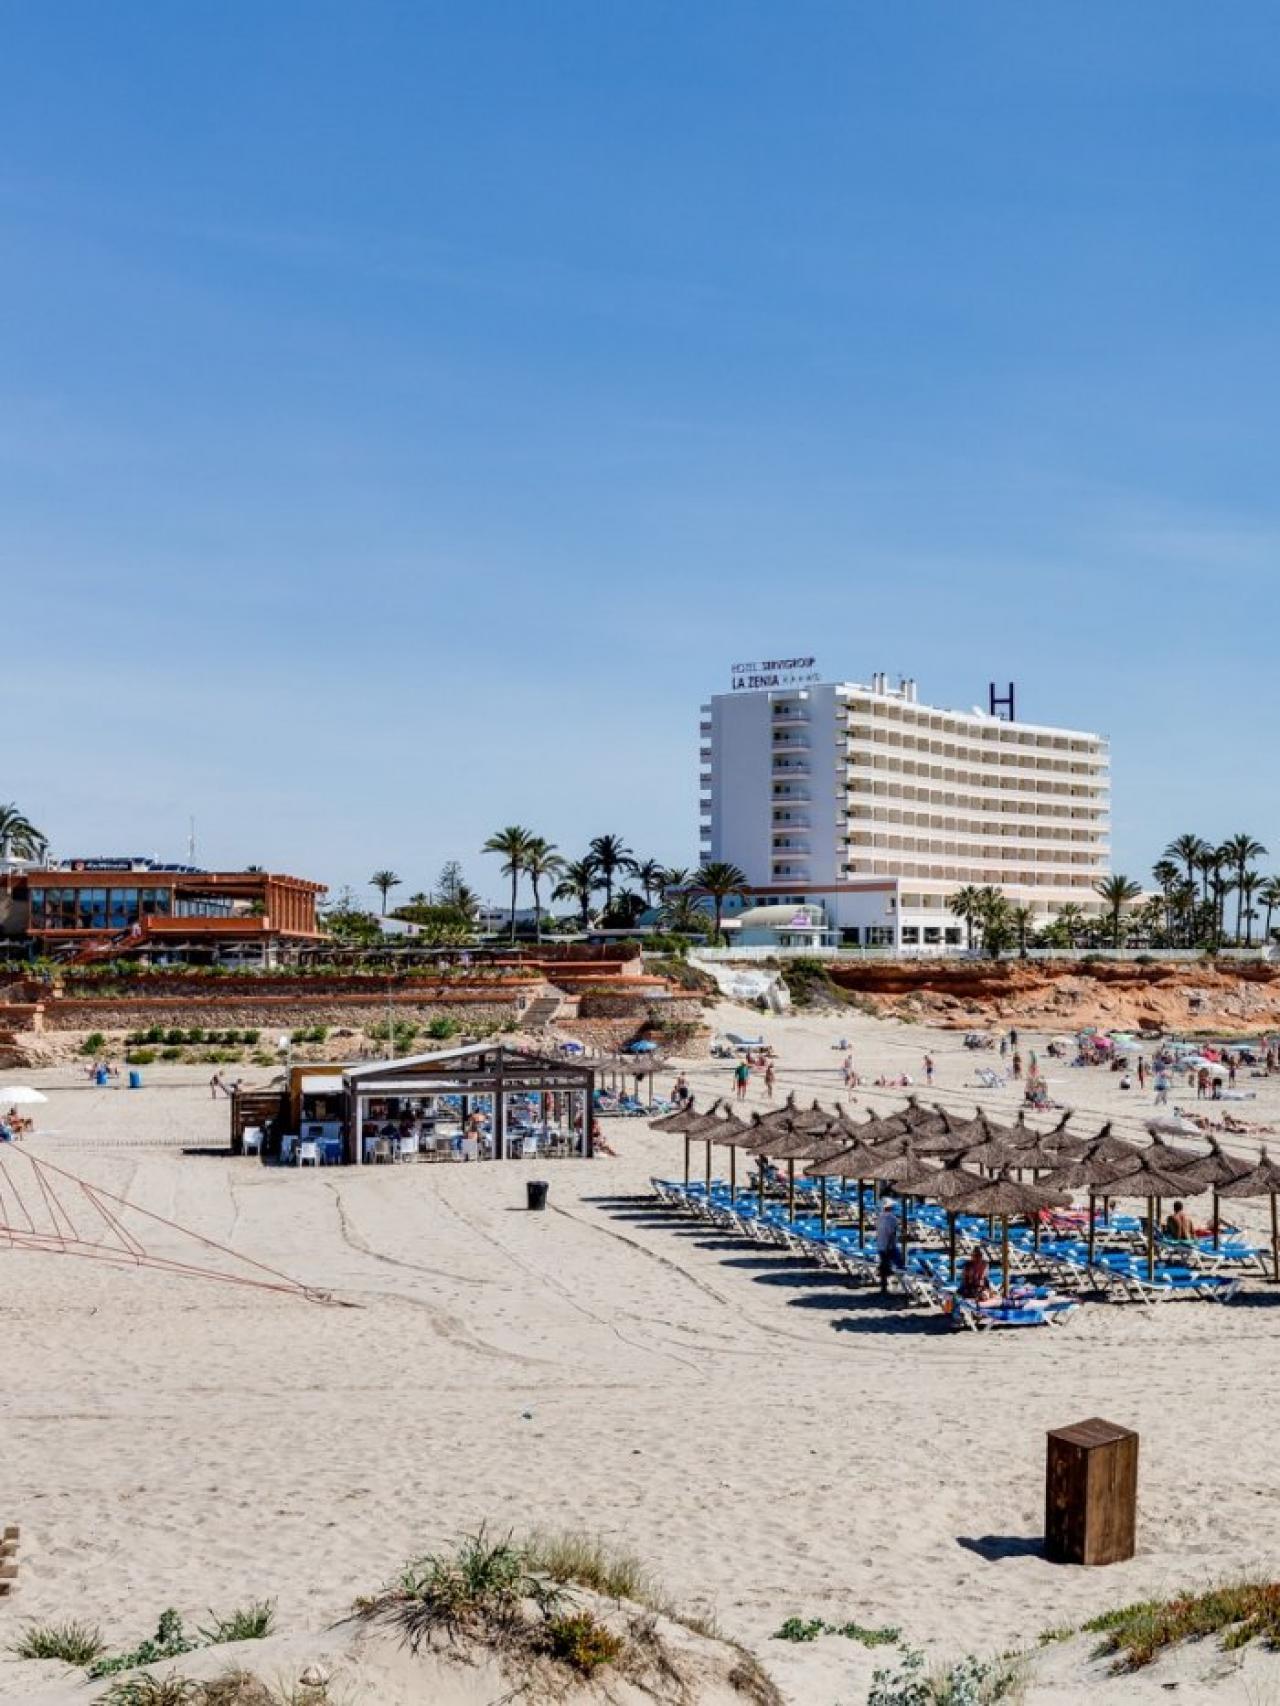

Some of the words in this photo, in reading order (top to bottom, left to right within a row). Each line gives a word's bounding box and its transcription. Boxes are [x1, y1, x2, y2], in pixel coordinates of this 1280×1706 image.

[731, 663, 756, 673] HOTEL
[732, 677, 745, 690] LA
[748, 675, 780, 689] ZENIA
[990, 682, 1014, 722] H
